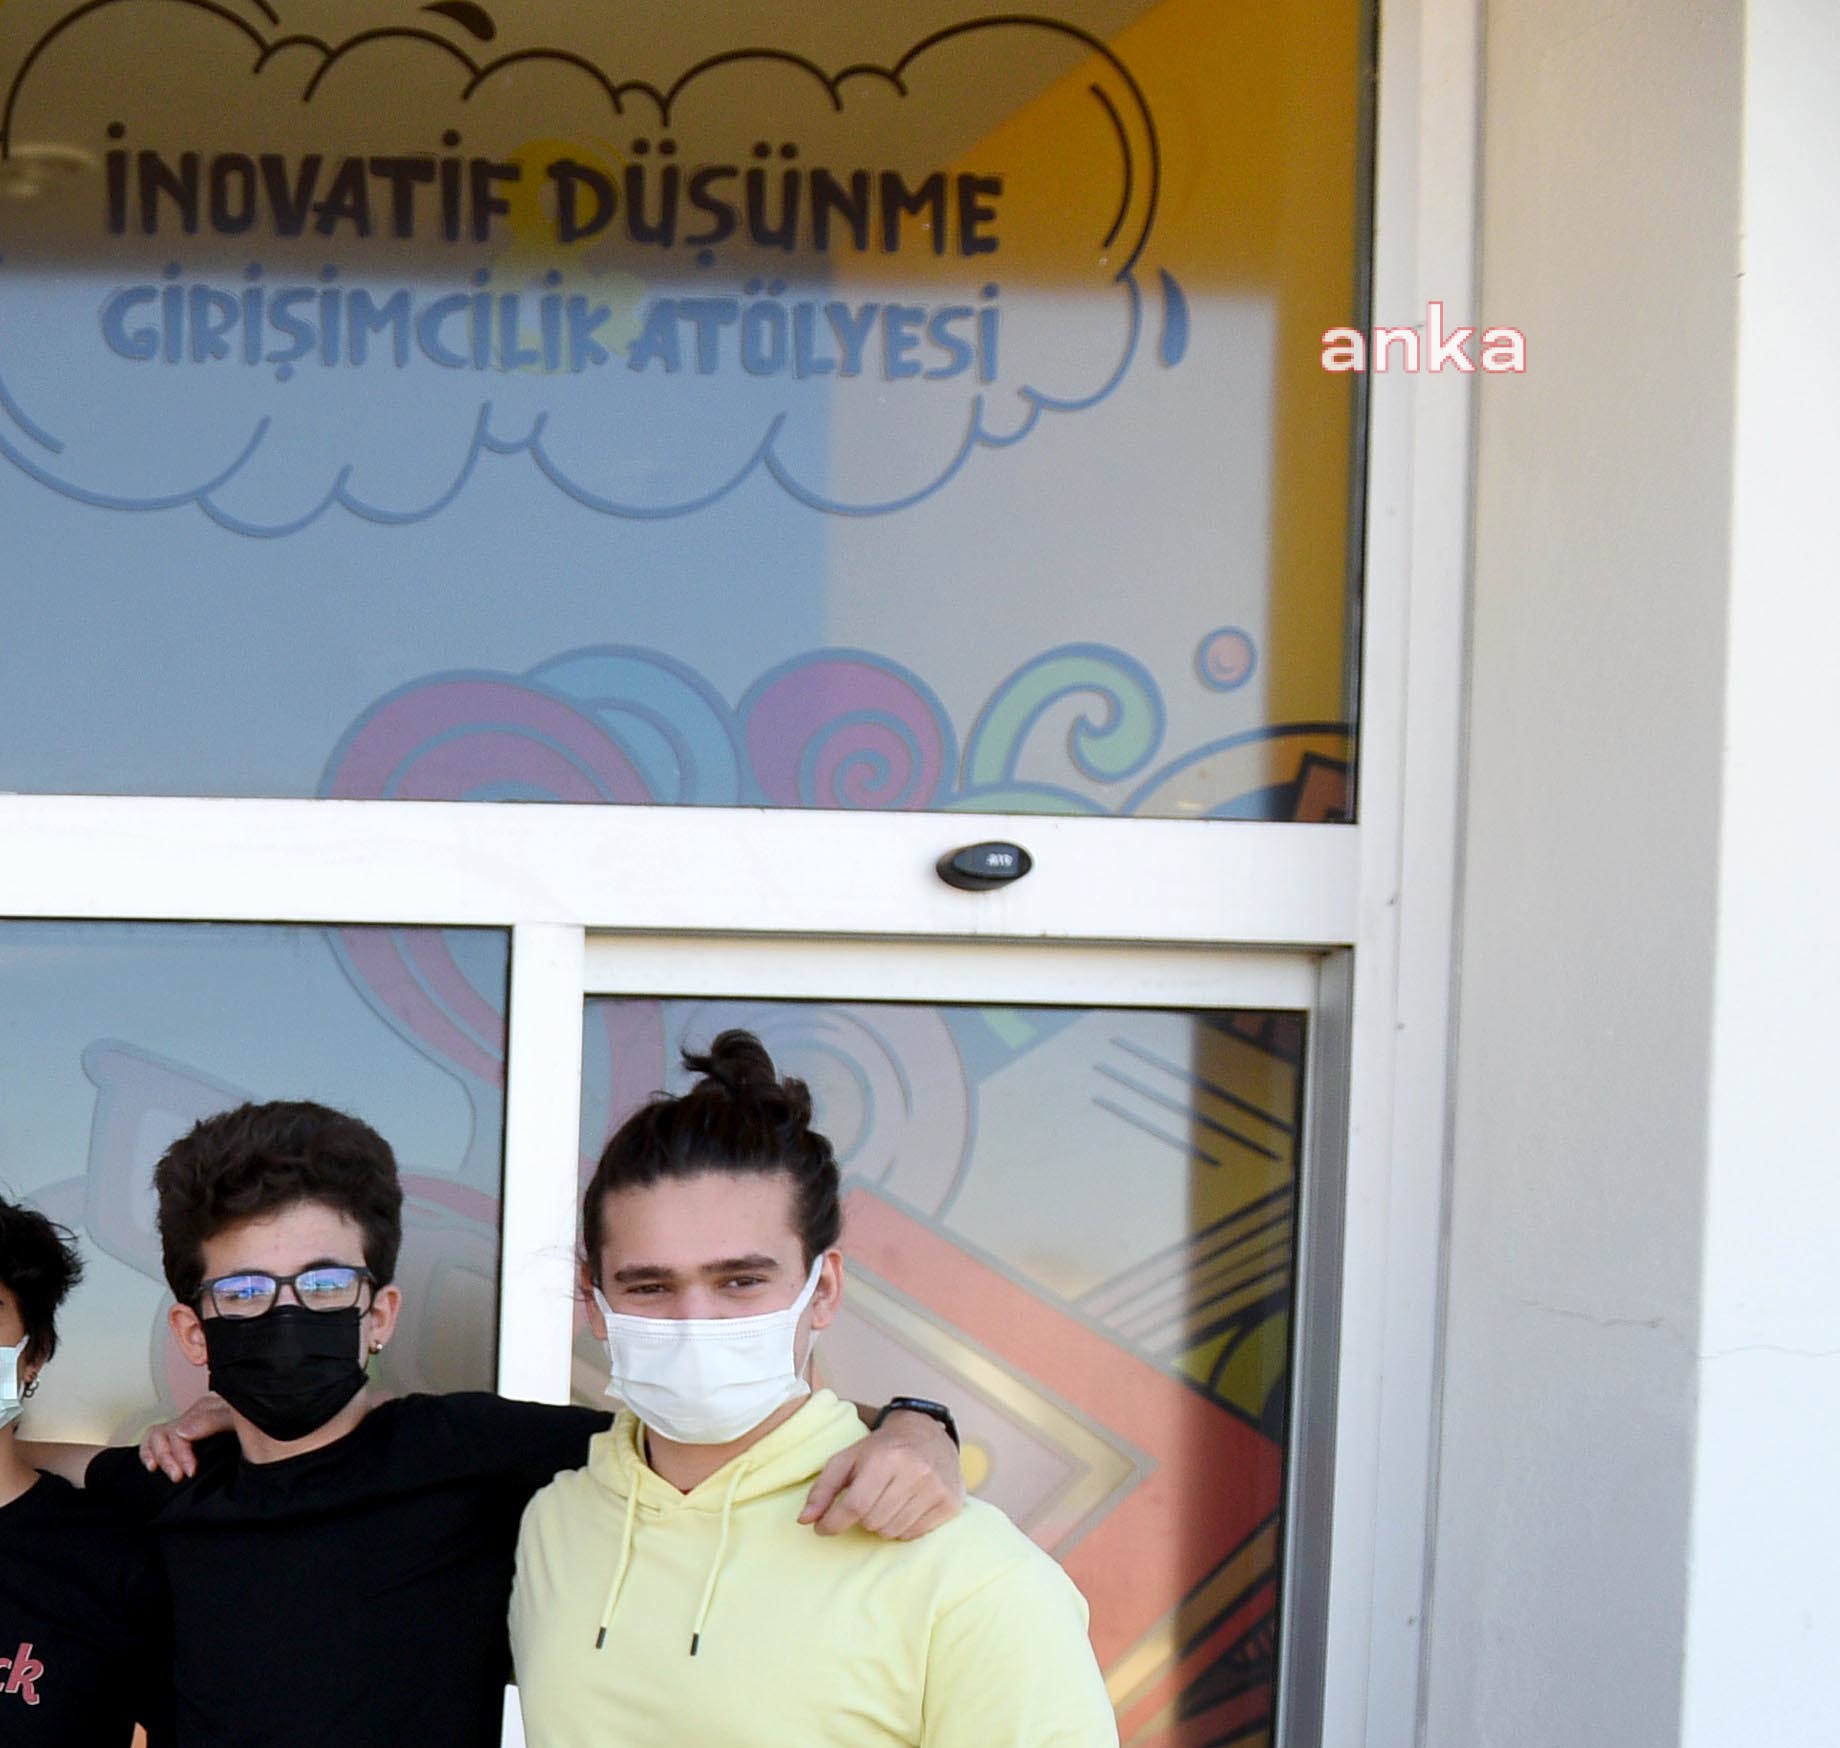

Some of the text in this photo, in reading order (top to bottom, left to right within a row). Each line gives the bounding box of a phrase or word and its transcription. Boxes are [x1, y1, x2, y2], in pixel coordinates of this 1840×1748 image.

[105, 121, 1004, 266] İNOVATİF DÜŞÜNME
[102, 262, 1003, 383] GİRİŞİMCİLİK ATÖLYESİ
